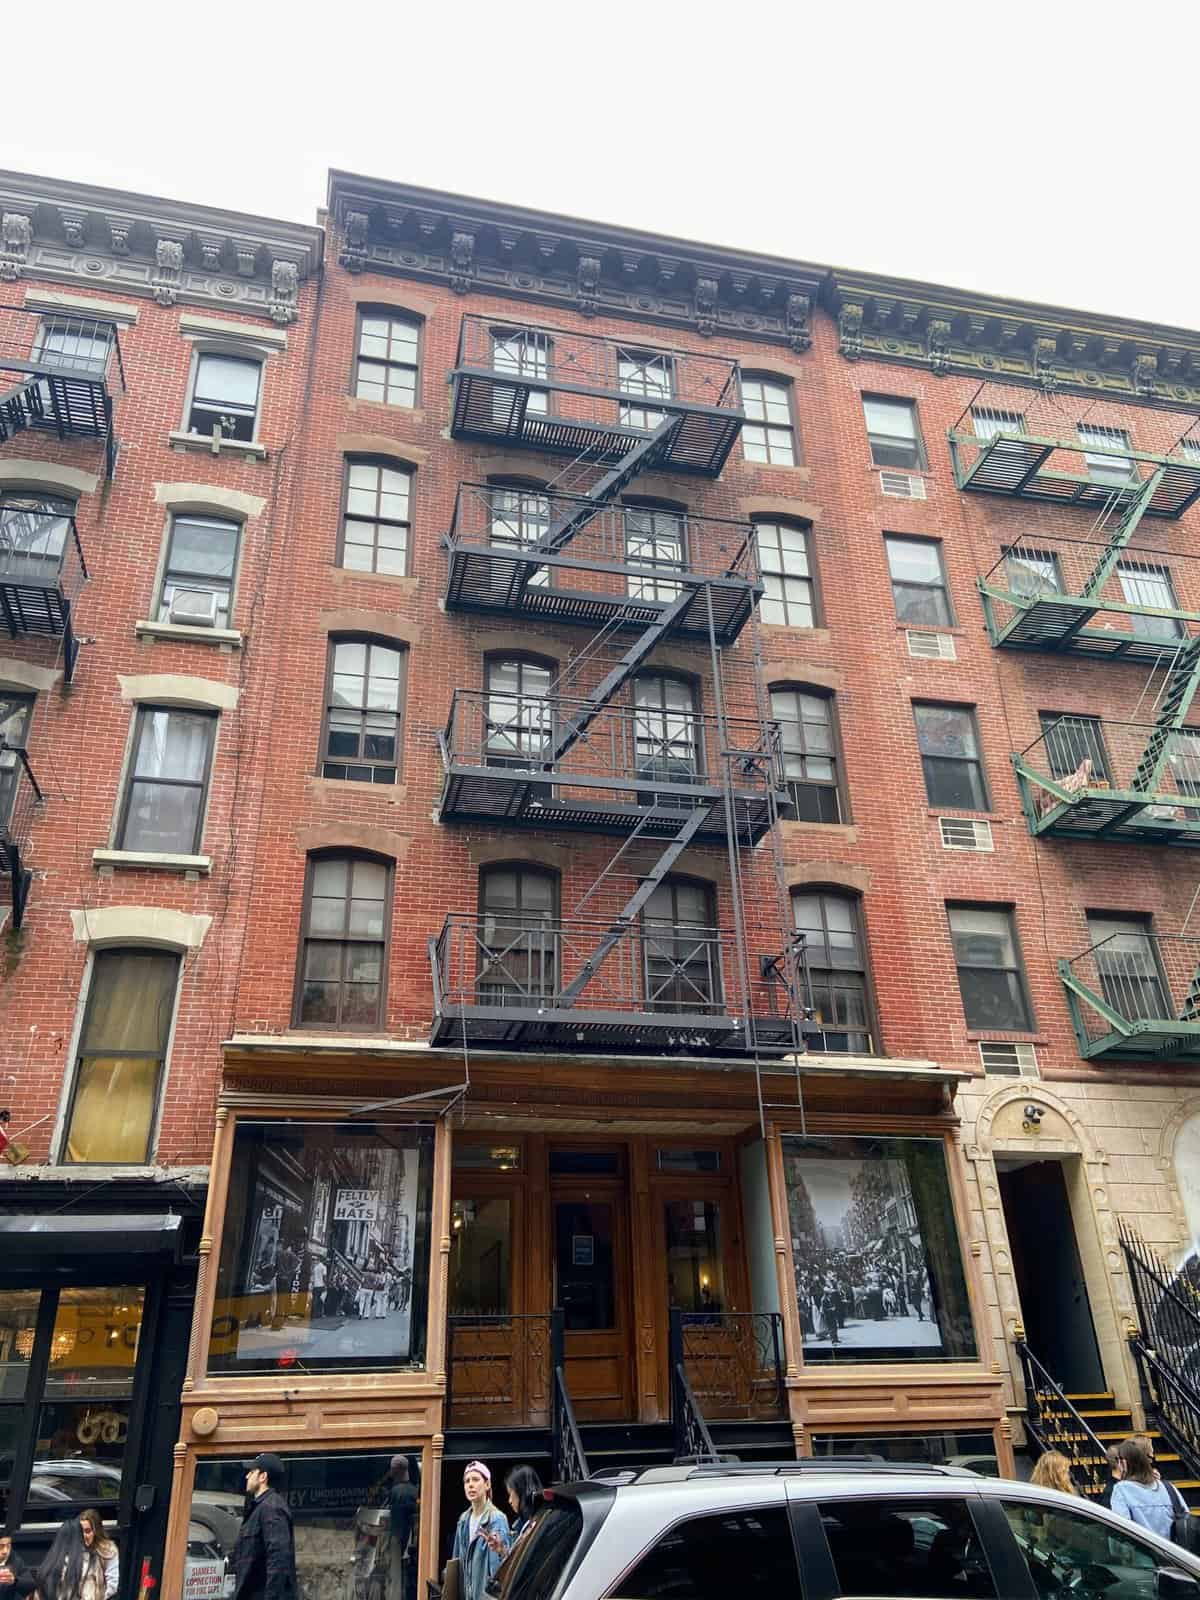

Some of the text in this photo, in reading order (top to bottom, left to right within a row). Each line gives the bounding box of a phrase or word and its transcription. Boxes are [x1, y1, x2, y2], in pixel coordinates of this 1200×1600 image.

[338, 1190, 378, 1203] FELTLY
[336, 1208, 374, 1219] HATS
[186, 1575, 222, 1586] CONNECTION
